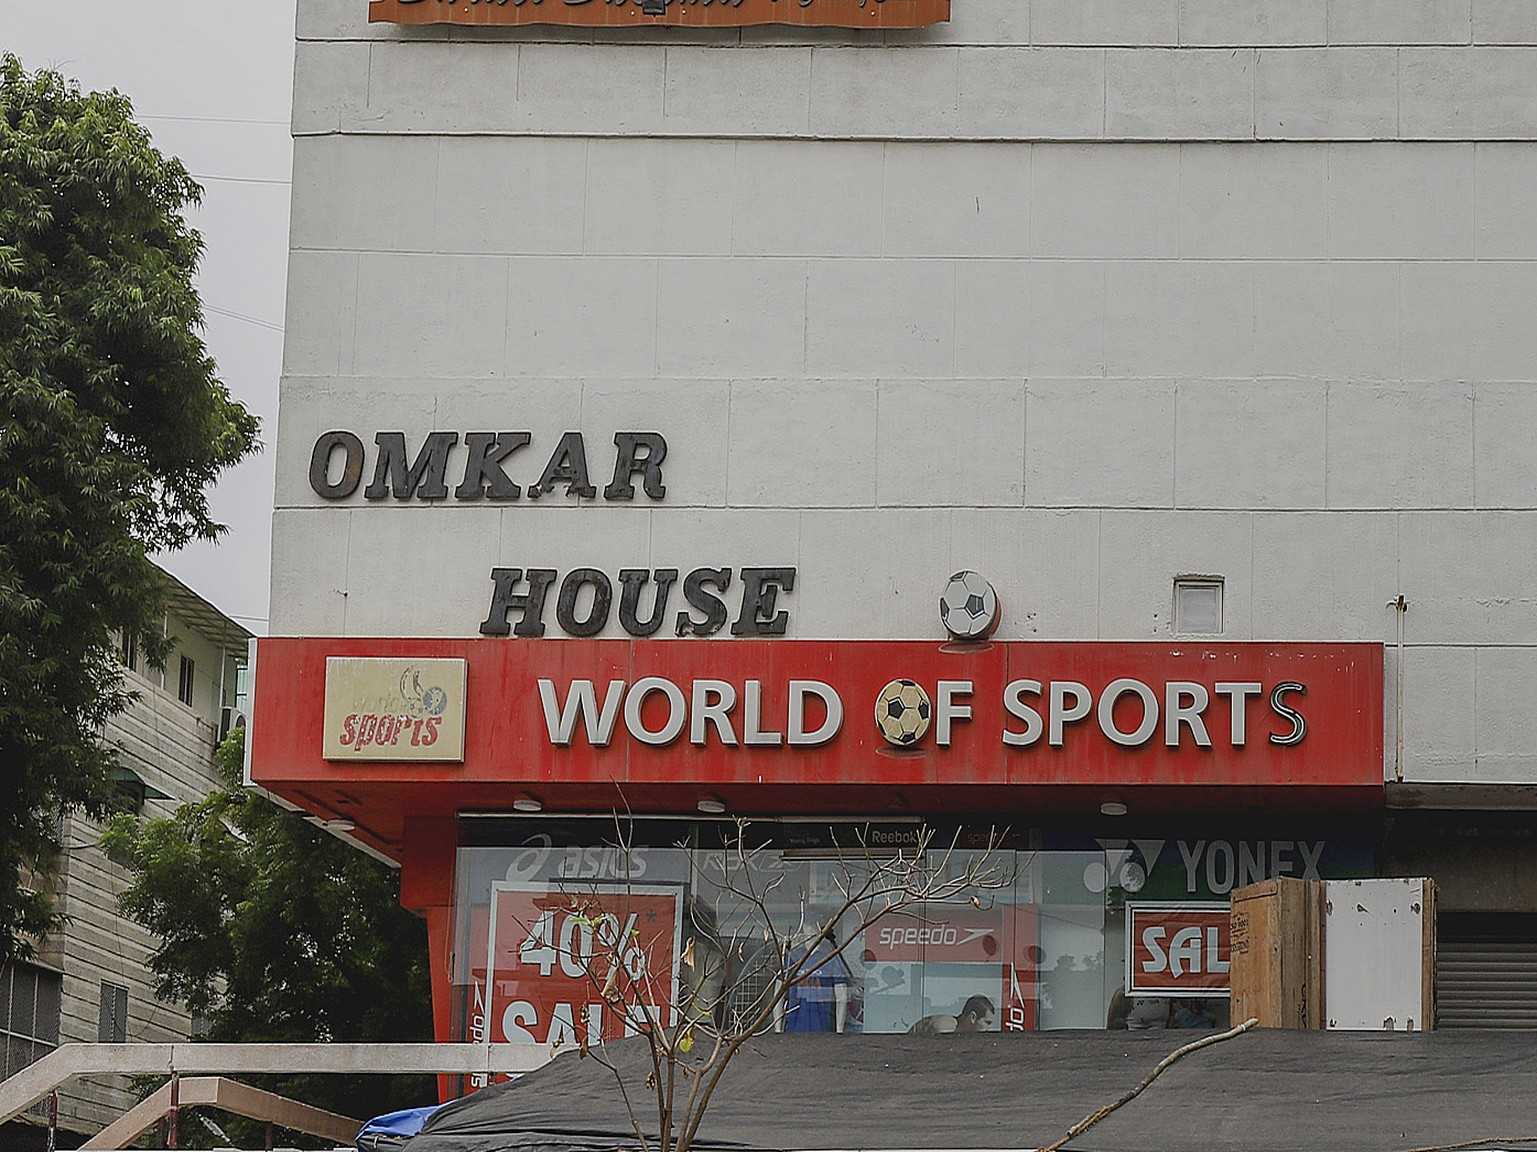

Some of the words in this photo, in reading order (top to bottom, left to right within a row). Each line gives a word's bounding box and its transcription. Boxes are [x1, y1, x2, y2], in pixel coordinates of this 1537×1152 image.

[308, 430, 670, 501] OMKAR
[478, 566, 797, 638] HOUSE
[339, 713, 443, 752] sports
[537, 676, 844, 747] WORLD
[1001, 677, 1308, 748] SPORTS
[558, 847, 647, 880] asics
[872, 830, 917, 844] Reebok
[1176, 839, 1326, 895] YONEX
[520, 909, 646, 981] 40%
[879, 925, 957, 950] speedo
[1141, 926, 1231, 979] SAL
